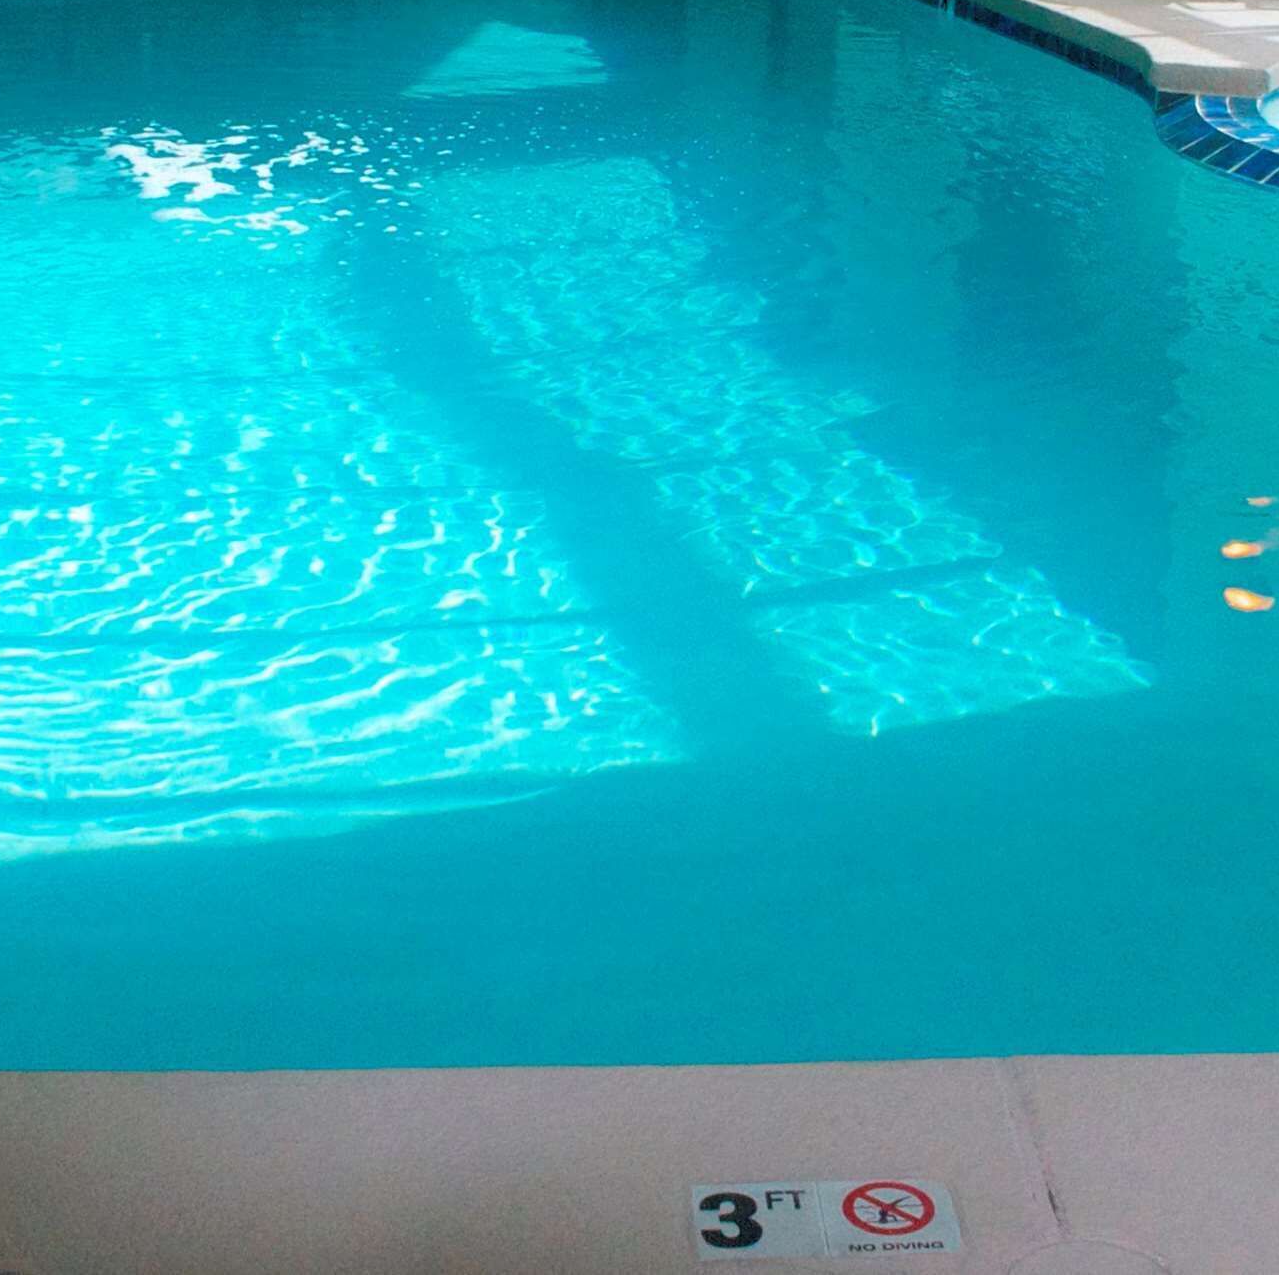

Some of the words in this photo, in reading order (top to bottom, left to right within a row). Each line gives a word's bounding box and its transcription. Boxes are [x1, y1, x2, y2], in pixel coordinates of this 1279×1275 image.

[699, 1192, 763, 1249] 3
[766, 1189, 805, 1211] FT
[848, 1242, 877, 1253] NO
[881, 1240, 945, 1252] DIVING
